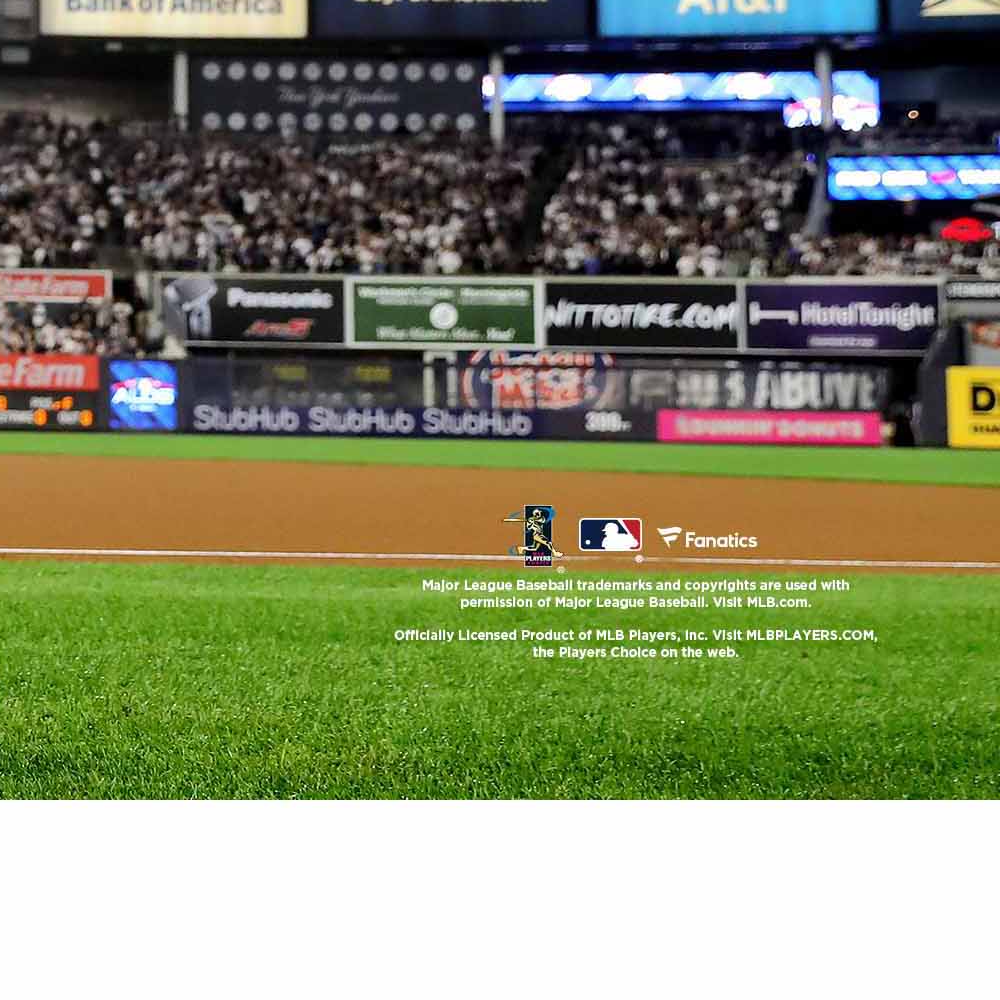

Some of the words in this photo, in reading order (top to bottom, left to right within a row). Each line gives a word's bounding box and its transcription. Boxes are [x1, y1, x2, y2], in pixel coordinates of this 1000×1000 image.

[193, 404, 299, 432] StubHub
[308, 405, 416, 434] StubHub
[422, 407, 533, 437] StubHub
